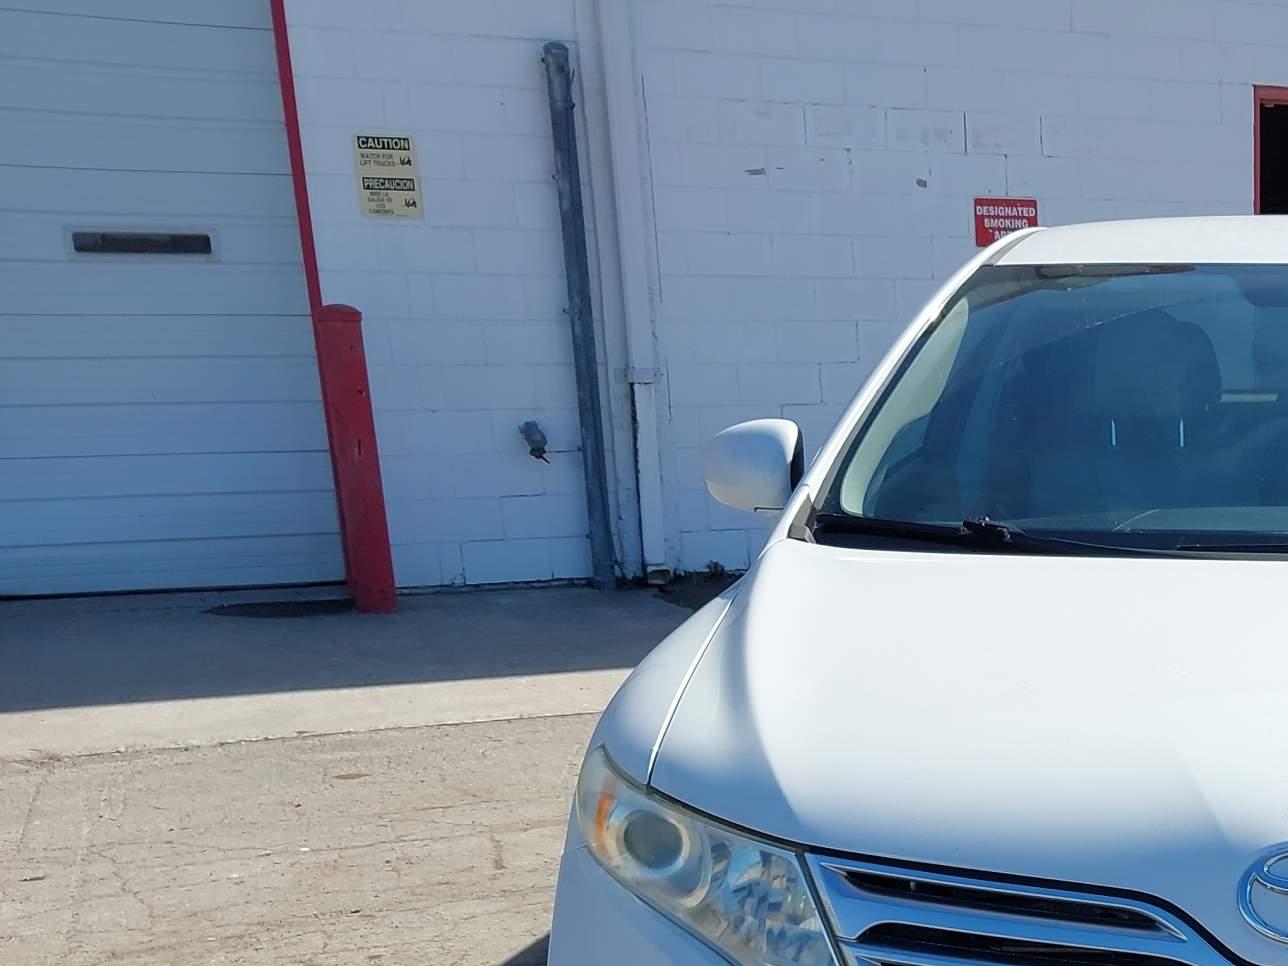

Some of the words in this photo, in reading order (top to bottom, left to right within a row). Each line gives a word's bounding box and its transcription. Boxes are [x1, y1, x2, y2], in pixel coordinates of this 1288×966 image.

[359, 137, 409, 150] CAUTION
[976, 205, 1036, 217] DESIGNATED
[984, 217, 1029, 229] SMOKING
